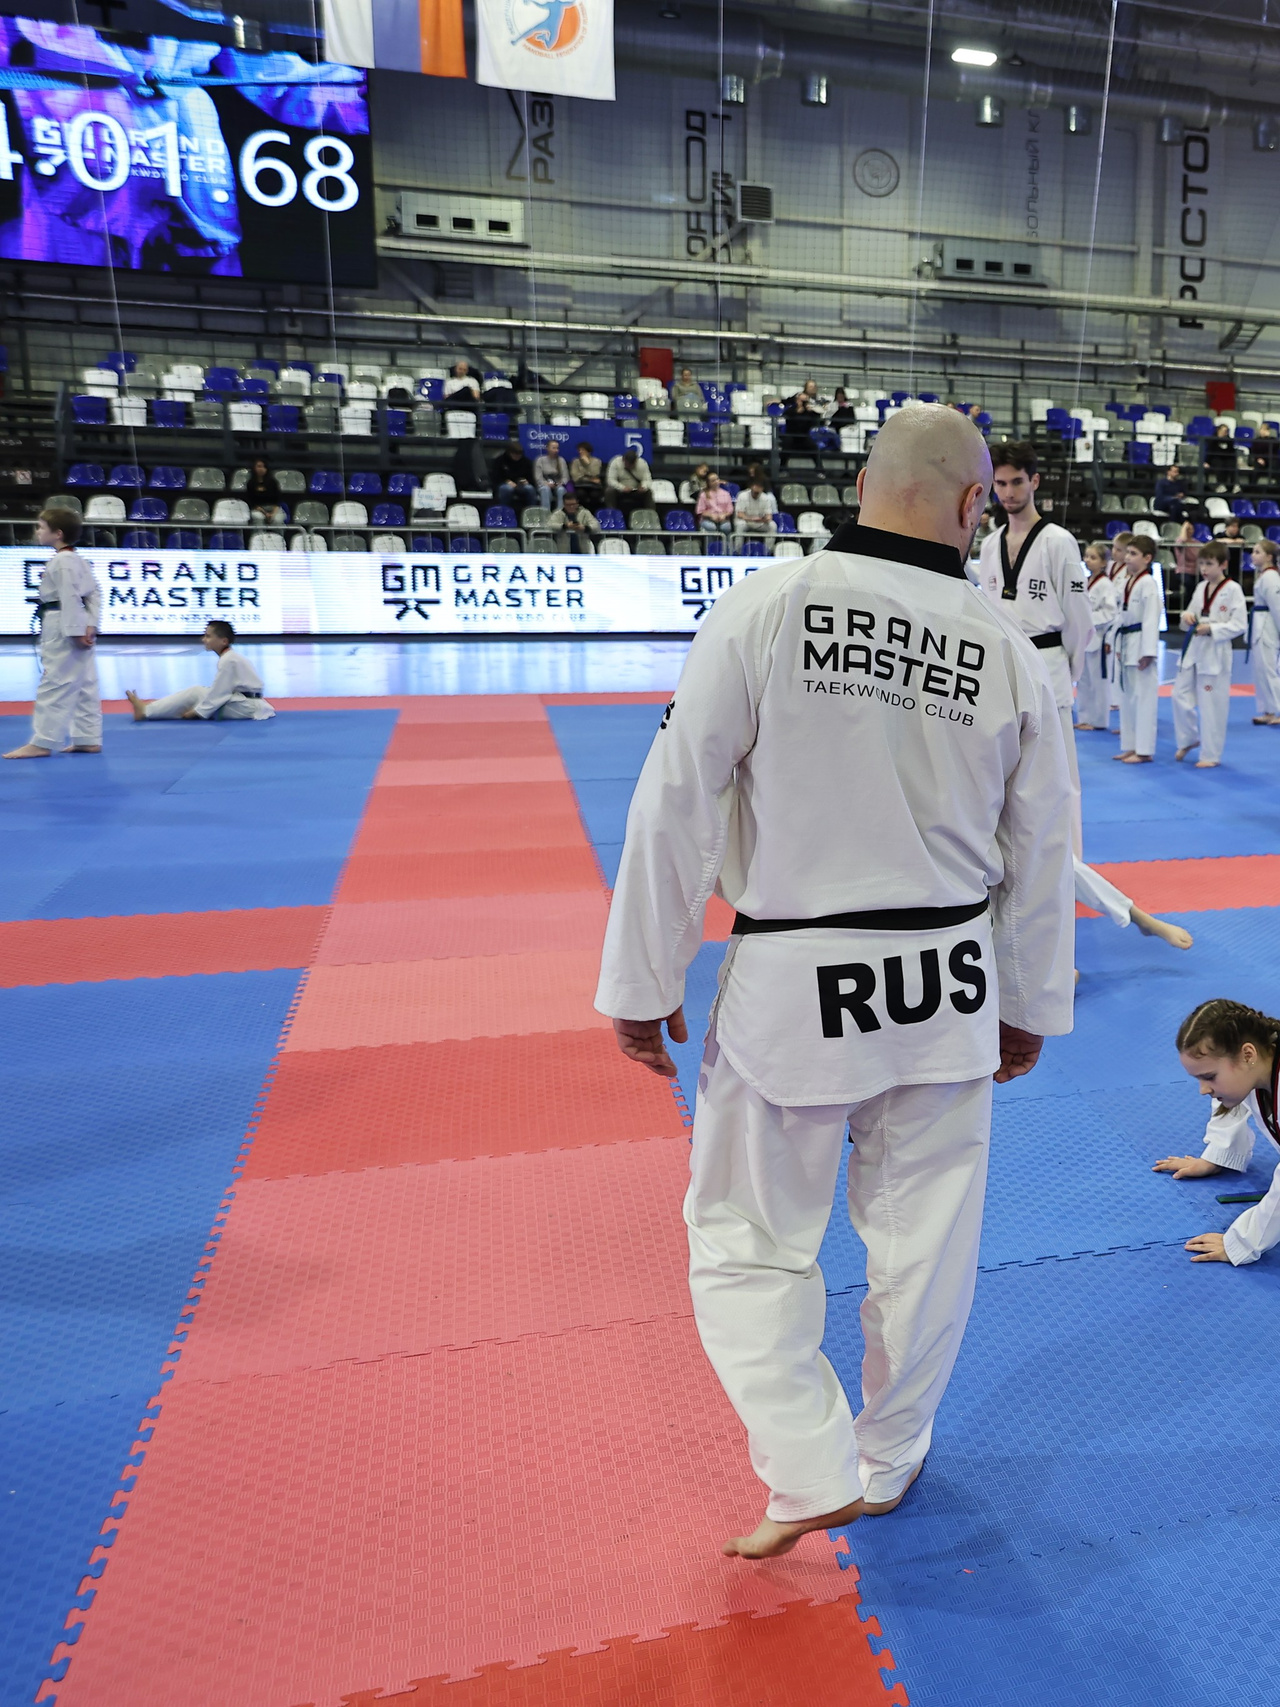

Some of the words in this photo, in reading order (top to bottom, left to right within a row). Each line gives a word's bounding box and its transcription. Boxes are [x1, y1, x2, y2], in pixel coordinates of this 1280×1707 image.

[1179, 126, 1210, 329] РОСТО
[529, 430, 570, 443] Сектор
[108, 561, 260, 582] GRAND
[381, 564, 441, 592] GM
[453, 565, 583, 583] GRAND
[108, 586, 261, 607] MASTER
[454, 588, 585, 608] MASTER
[804, 604, 986, 672] GRAND
[804, 640, 981, 707] MASTER
[925, 703, 974, 727] CLUB
[816, 940, 986, 1038] RUS
